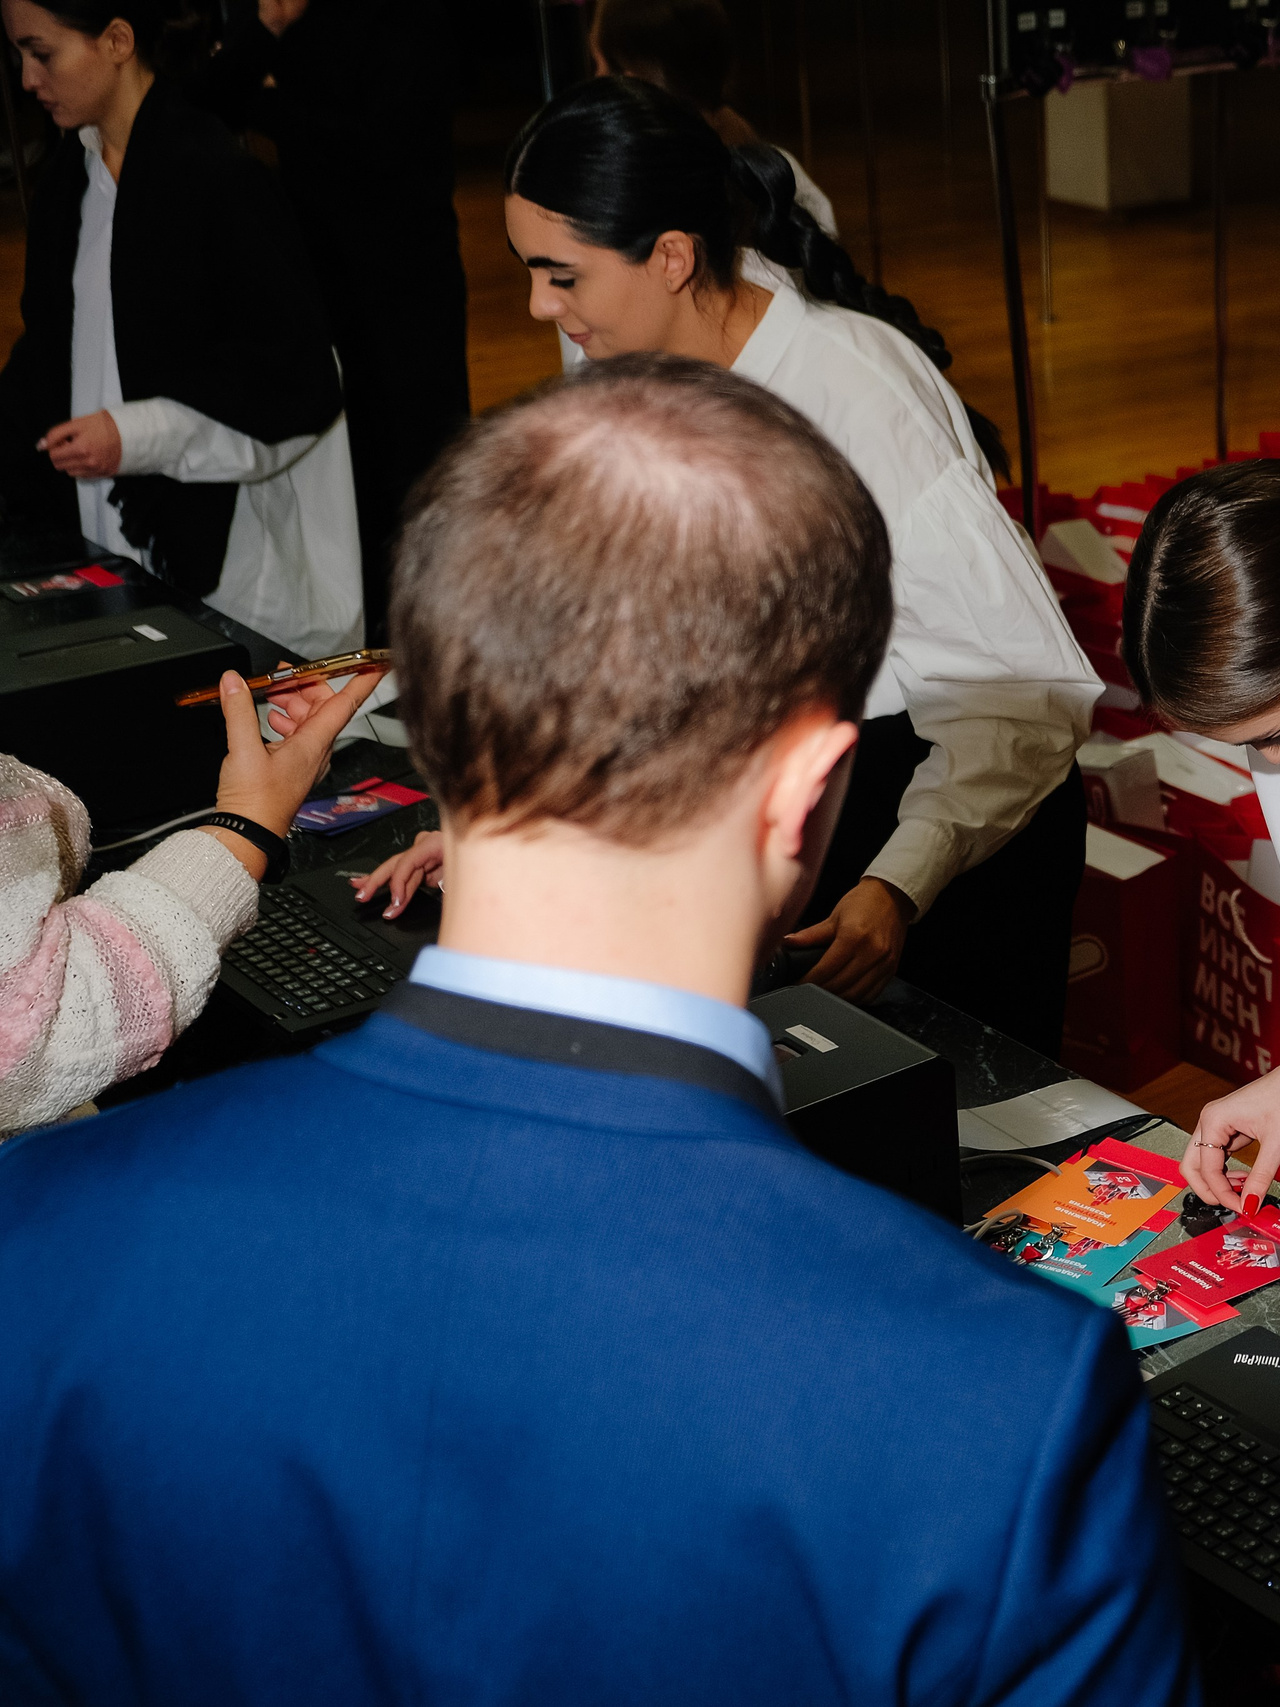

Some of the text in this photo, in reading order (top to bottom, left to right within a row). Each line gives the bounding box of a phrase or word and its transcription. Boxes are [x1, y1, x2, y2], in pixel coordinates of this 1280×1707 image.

[1200, 871, 1247, 942] ВСЕ
[1194, 961, 1262, 1039] МЕН
[1053, 1200, 1117, 1226] Инструменты
[1054, 1207, 1106, 1229] Надежные
[1068, 1200, 1112, 1219] Развития
[1170, 1265, 1213, 1290] Надежные
[1188, 1261, 1225, 1282] Развития
